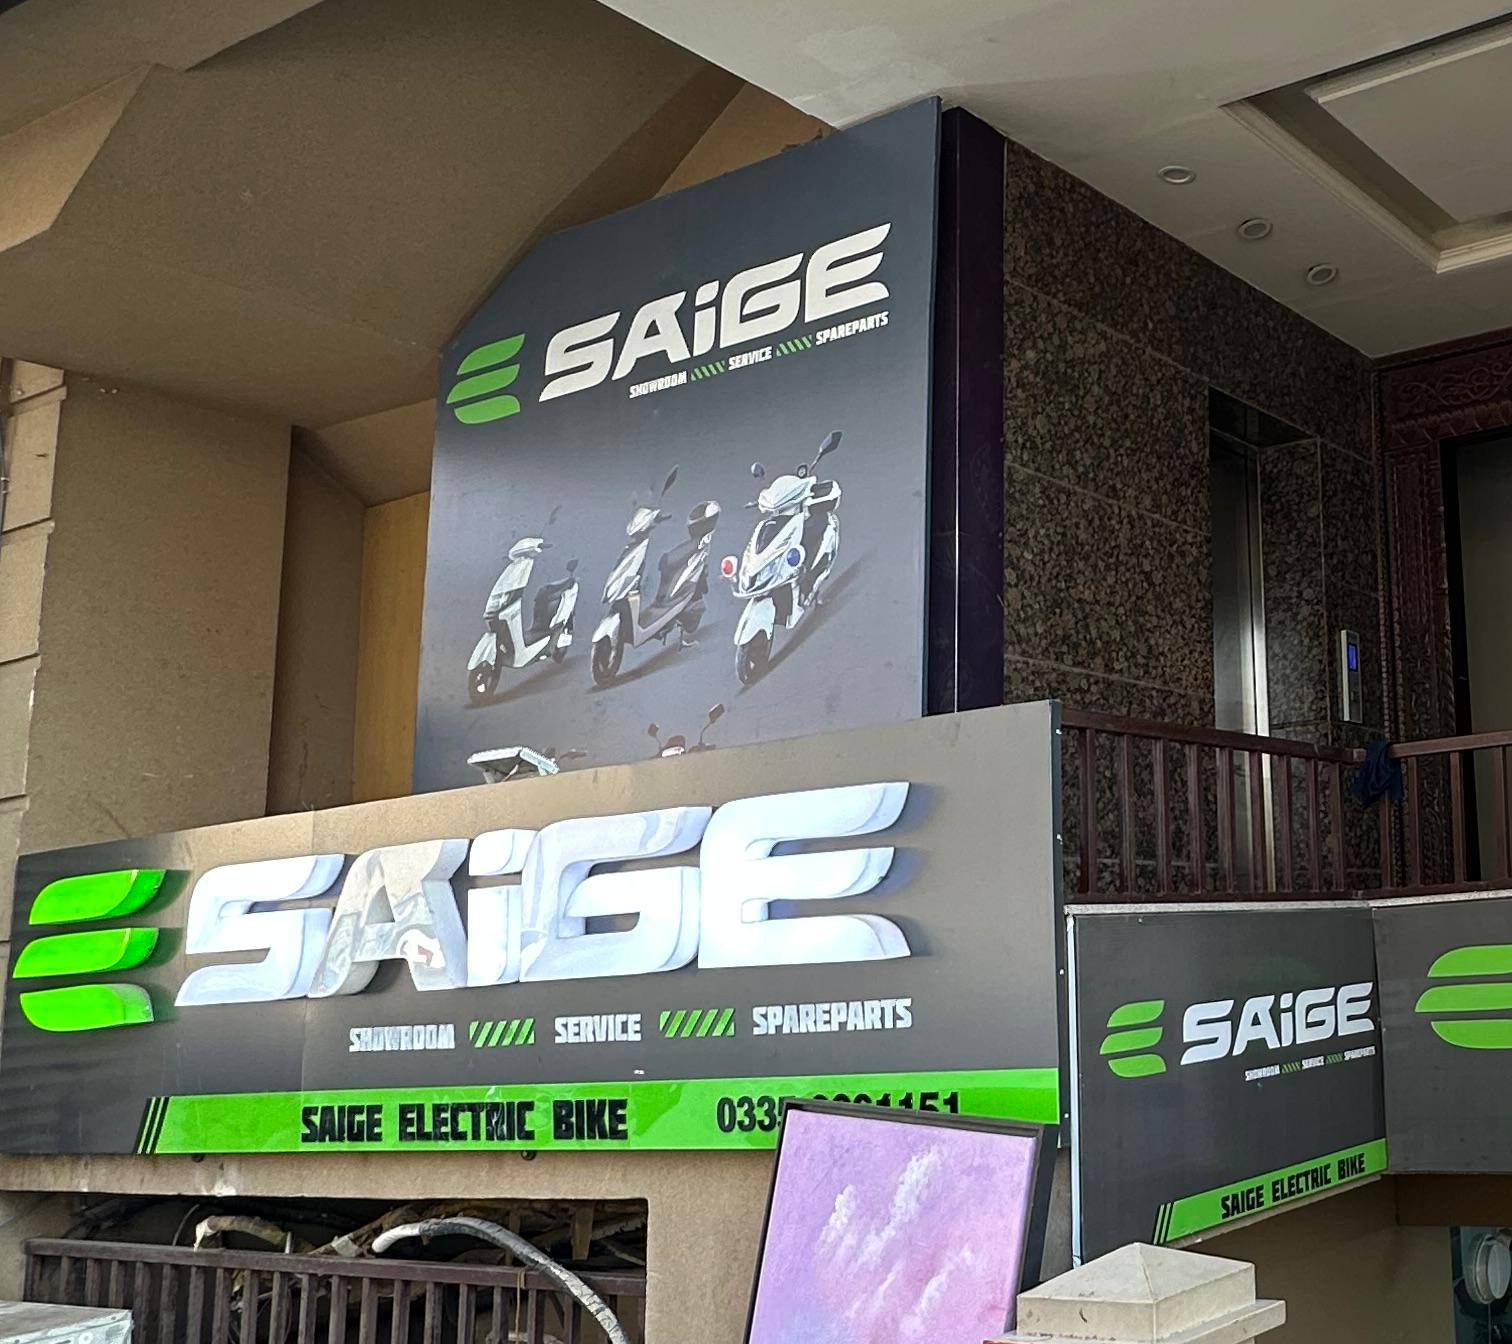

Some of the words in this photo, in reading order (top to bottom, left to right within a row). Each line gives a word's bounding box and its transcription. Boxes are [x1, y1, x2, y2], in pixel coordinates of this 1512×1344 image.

[728, 346, 773, 371] SERVICE
[815, 311, 889, 346] SPAREPARTS
[348, 1022, 455, 1054] SHOWROOM
[553, 1012, 642, 1044] SERVICE
[751, 998, 913, 1036] SPAREPARTS
[300, 1101, 384, 1143] SAIGE
[398, 1098, 536, 1142] ELECTRIC
[552, 1097, 630, 1139] BIKE
[1220, 1184, 1265, 1221] SAIGE
[1271, 1163, 1332, 1204] ELECTRIC
[1337, 1152, 1366, 1180] BIKE
